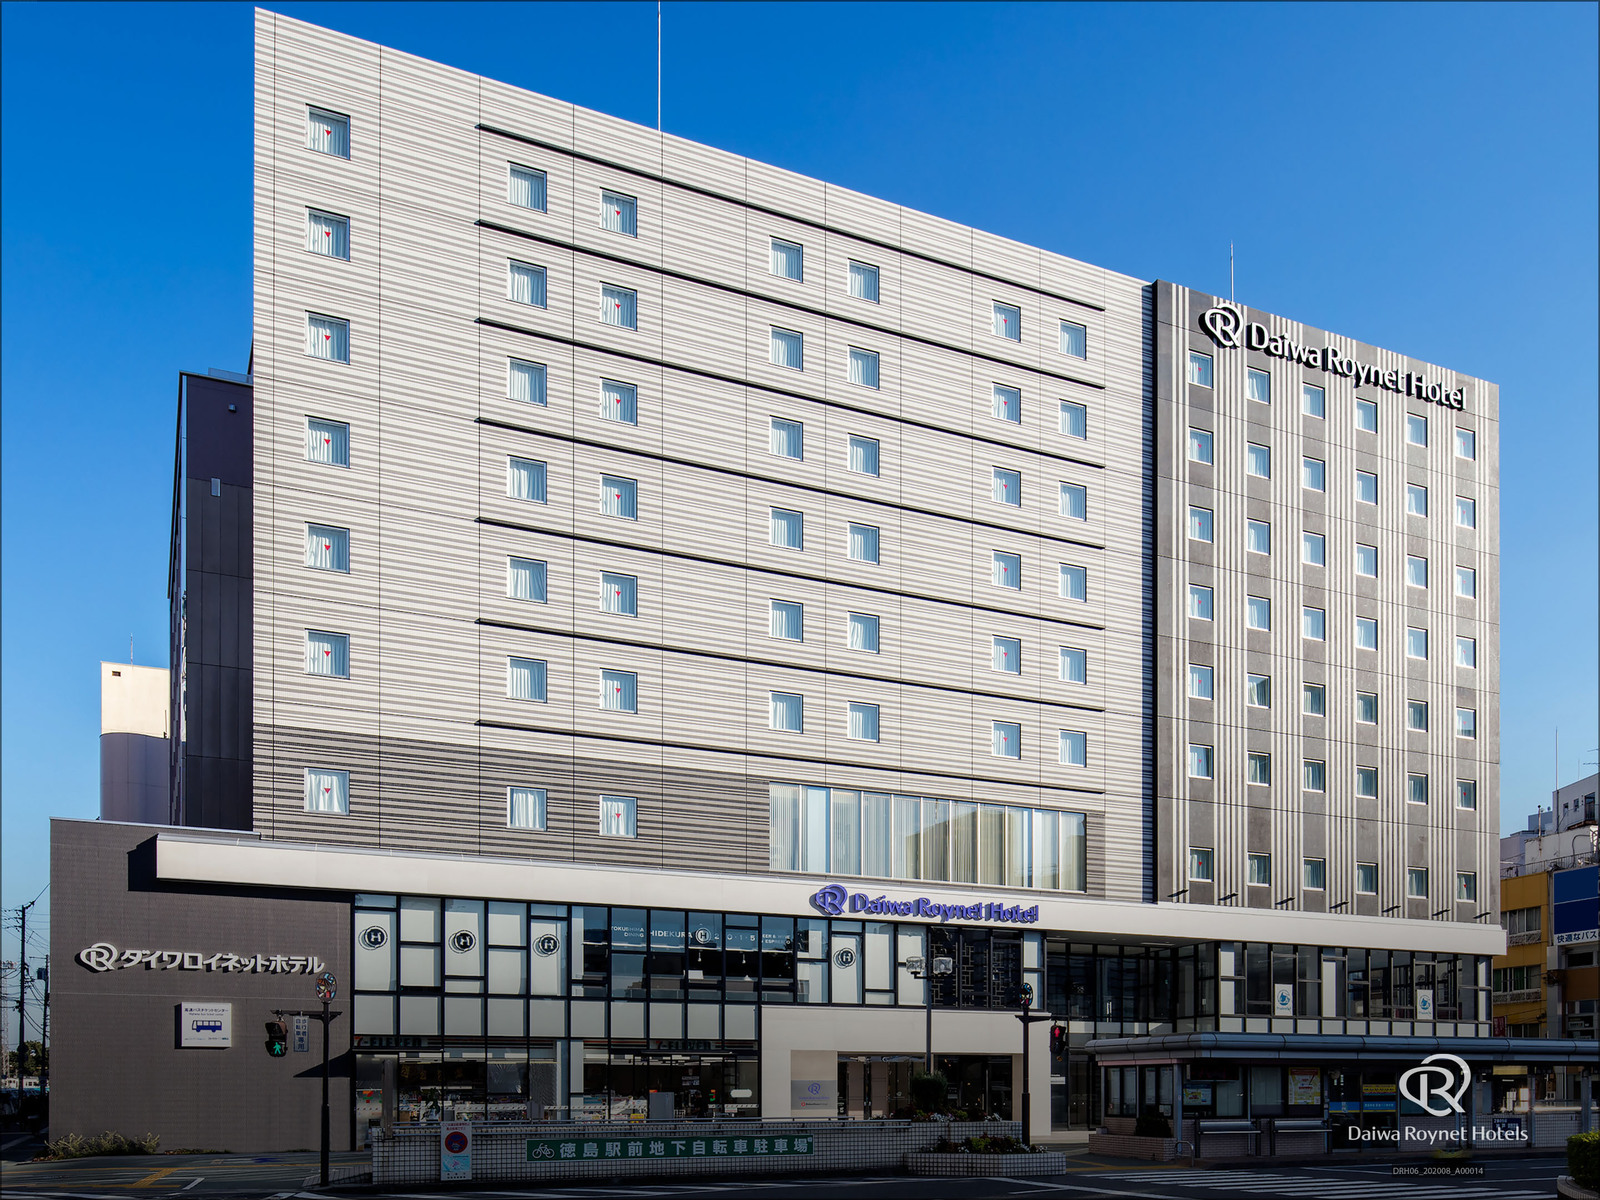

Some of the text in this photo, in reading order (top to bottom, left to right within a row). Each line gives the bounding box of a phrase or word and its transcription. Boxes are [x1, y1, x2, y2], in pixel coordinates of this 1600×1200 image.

[1251, 322, 1321, 366] Daiwa
[1327, 346, 1406, 388] Roynet
[1411, 371, 1466, 409] Hotel
[854, 893, 914, 915] Daiwa
[919, 897, 985, 922] Roynet
[990, 901, 1039, 922] Hotel
[1556, 930, 1600, 944] 快適なバス
[120, 949, 326, 974] ダイワロイネットホテル
[559, 1138, 809, 1159] 徳島駅前地下自転車駐車場
